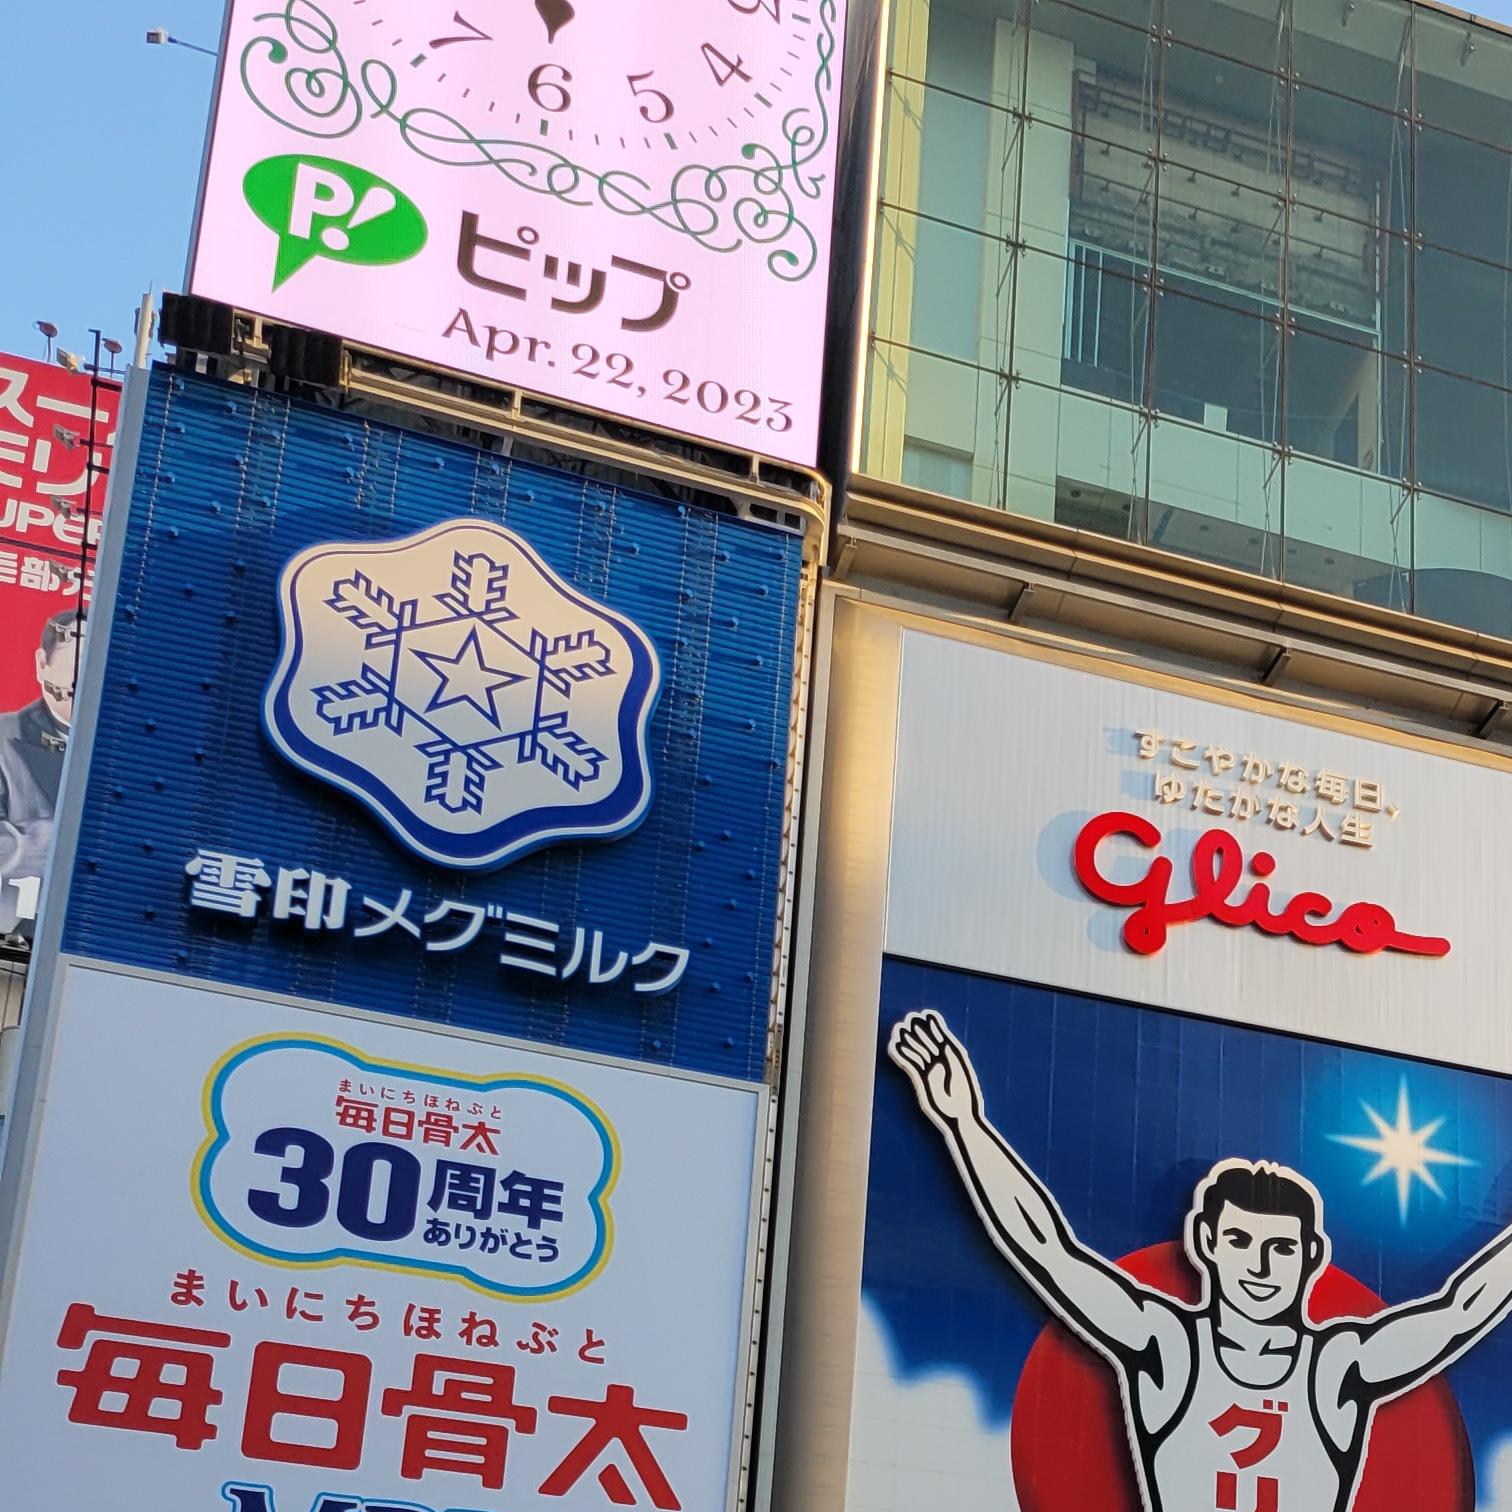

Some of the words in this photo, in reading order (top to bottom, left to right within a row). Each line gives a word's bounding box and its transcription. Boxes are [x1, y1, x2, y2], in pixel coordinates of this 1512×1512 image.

[429, 11, 493, 49] 7
[701, 43, 752, 87] 4
[528, 63, 572, 112] 6
[626, 70, 674, 124] 5
[457, 209, 692, 333] ピップ
[441, 307, 556, 368] Apr.
[571, 343, 648, 398] 22,
[662, 368, 794, 434] 2023
[1133, 727, 1402, 820] すこやかな毎日、
[1152, 769, 1378, 848] ゆたかな人生
[186, 848, 691, 992] 雪印メグミルク
[335, 1095, 501, 1156] 毎日骨太
[338, 1079, 502, 1120] まいにちほねぶと
[426, 1158, 565, 1231] 周年
[422, 1217, 560, 1263] ありがとう
[170, 1268, 607, 1366] まいにちほねぶと
[56, 1302, 690, 1512] 毎日骨太
